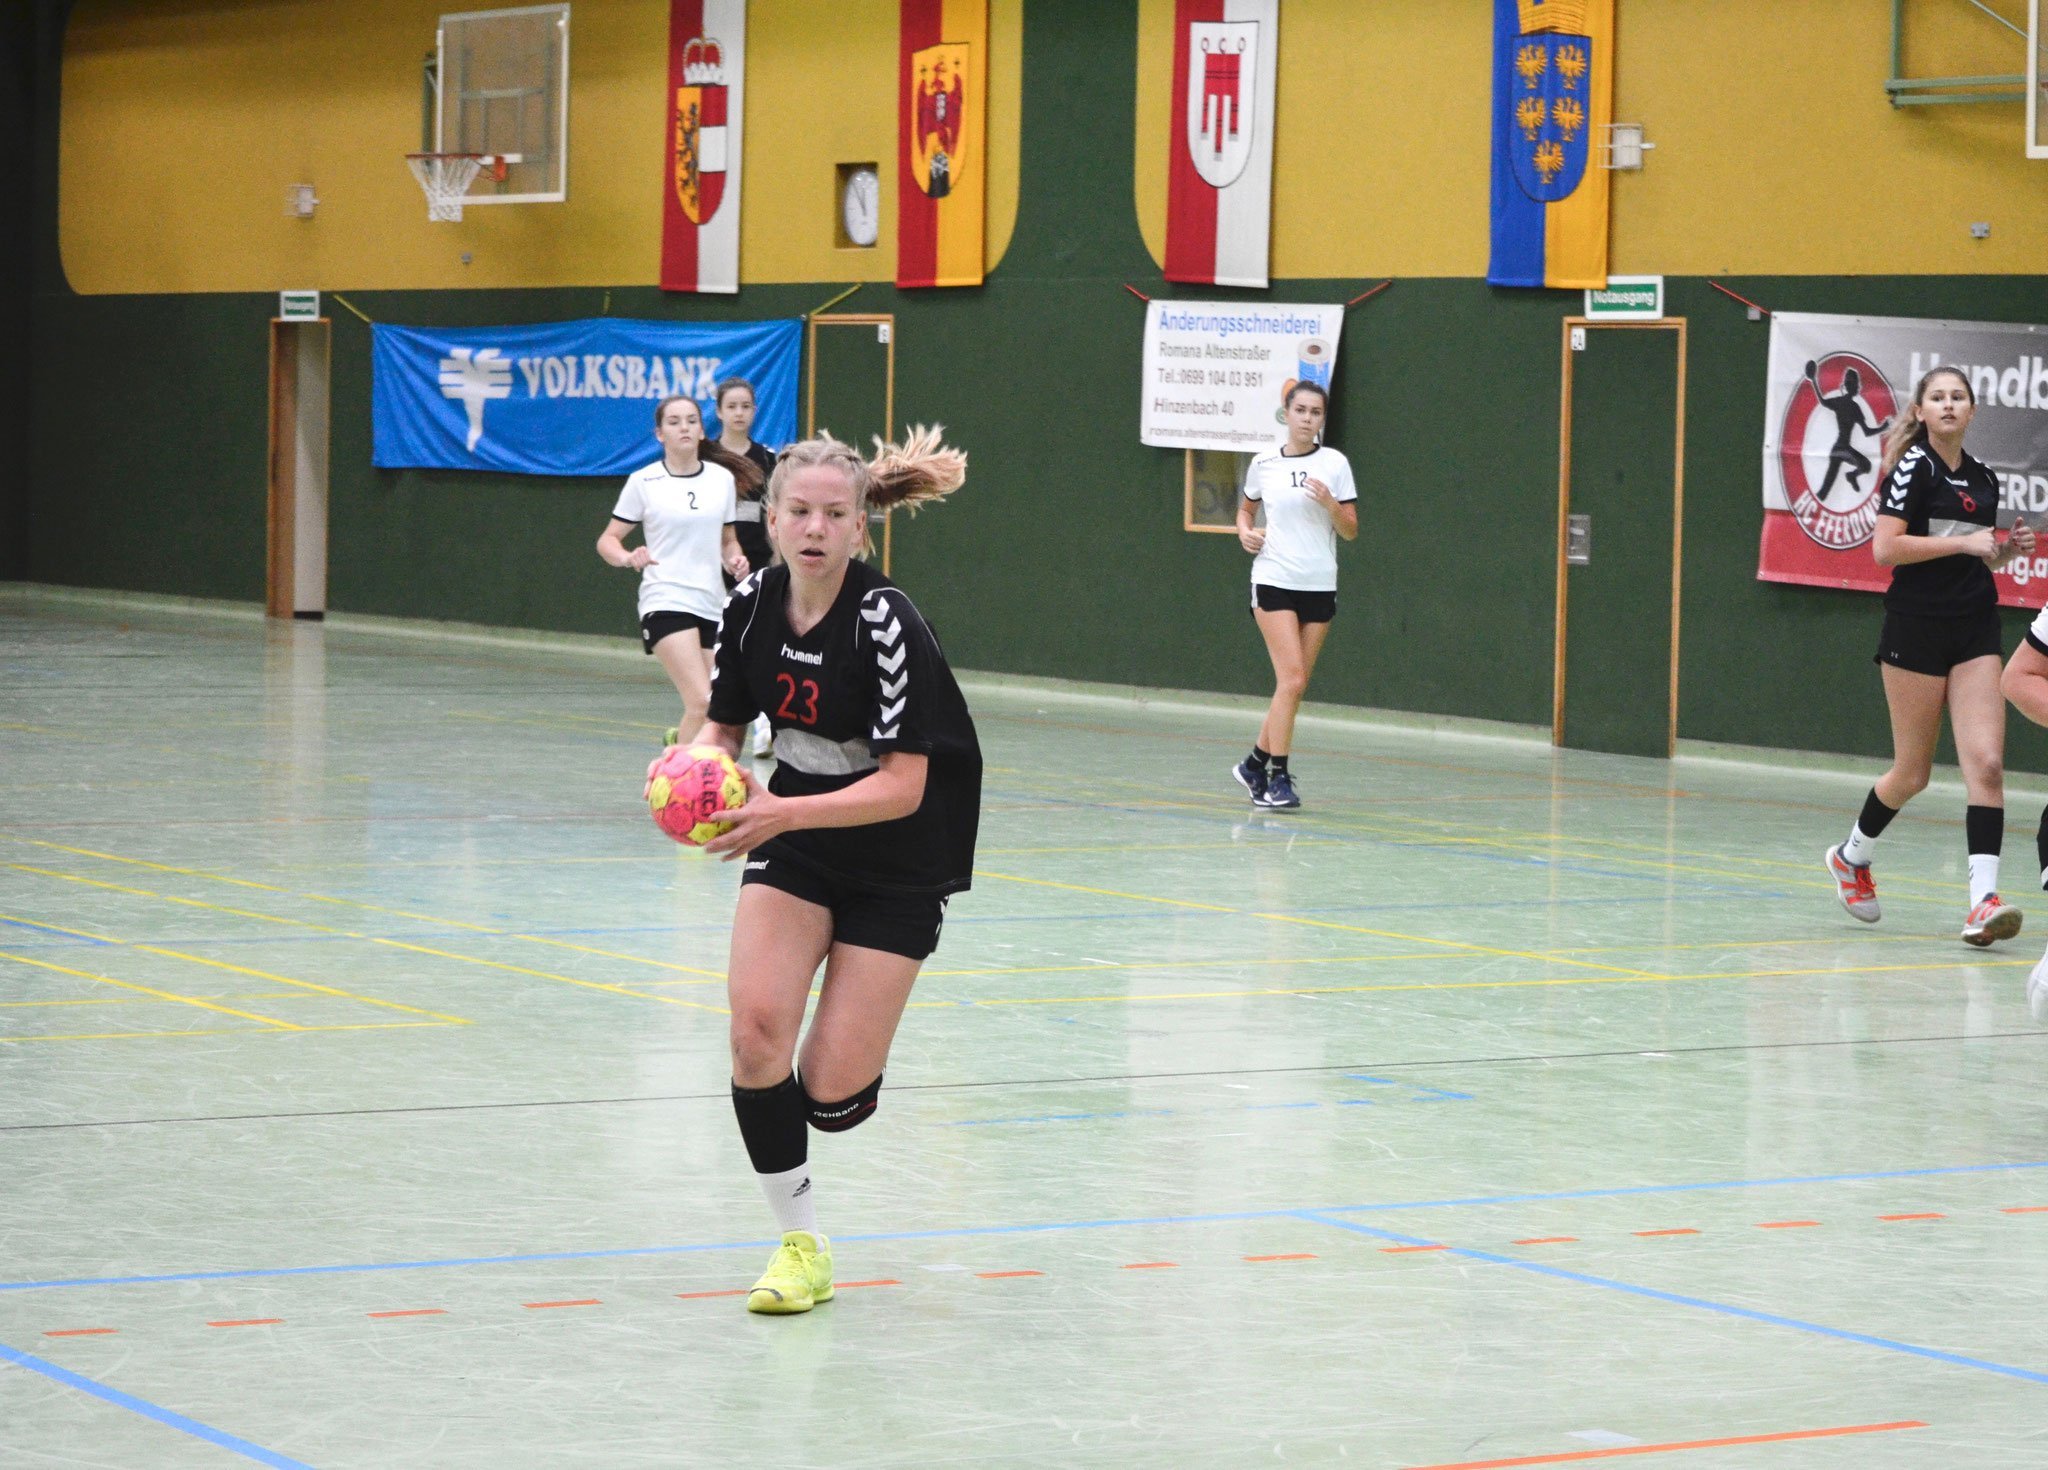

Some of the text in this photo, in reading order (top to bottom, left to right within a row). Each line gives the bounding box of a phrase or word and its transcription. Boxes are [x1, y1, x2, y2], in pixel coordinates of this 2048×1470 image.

[1592, 290, 1655, 307] Notausgang
[1159, 306, 1321, 337] Änderungsschneiderei
[1159, 342, 1271, 361] Romana Altenstraßer
[518, 354, 721, 400] VOLKSBANK
[1208, 370, 1226, 386] 104
[1229, 371, 1241, 387] 03
[1244, 372, 1263, 388] 951
[1154, 398, 1234, 416] Hinzenbach 40
[1290, 471, 1308, 488] 12
[687, 491, 699, 511] 2
[1794, 490, 1818, 525] HC
[781, 643, 823, 666] hummel
[776, 672, 820, 726] 23
